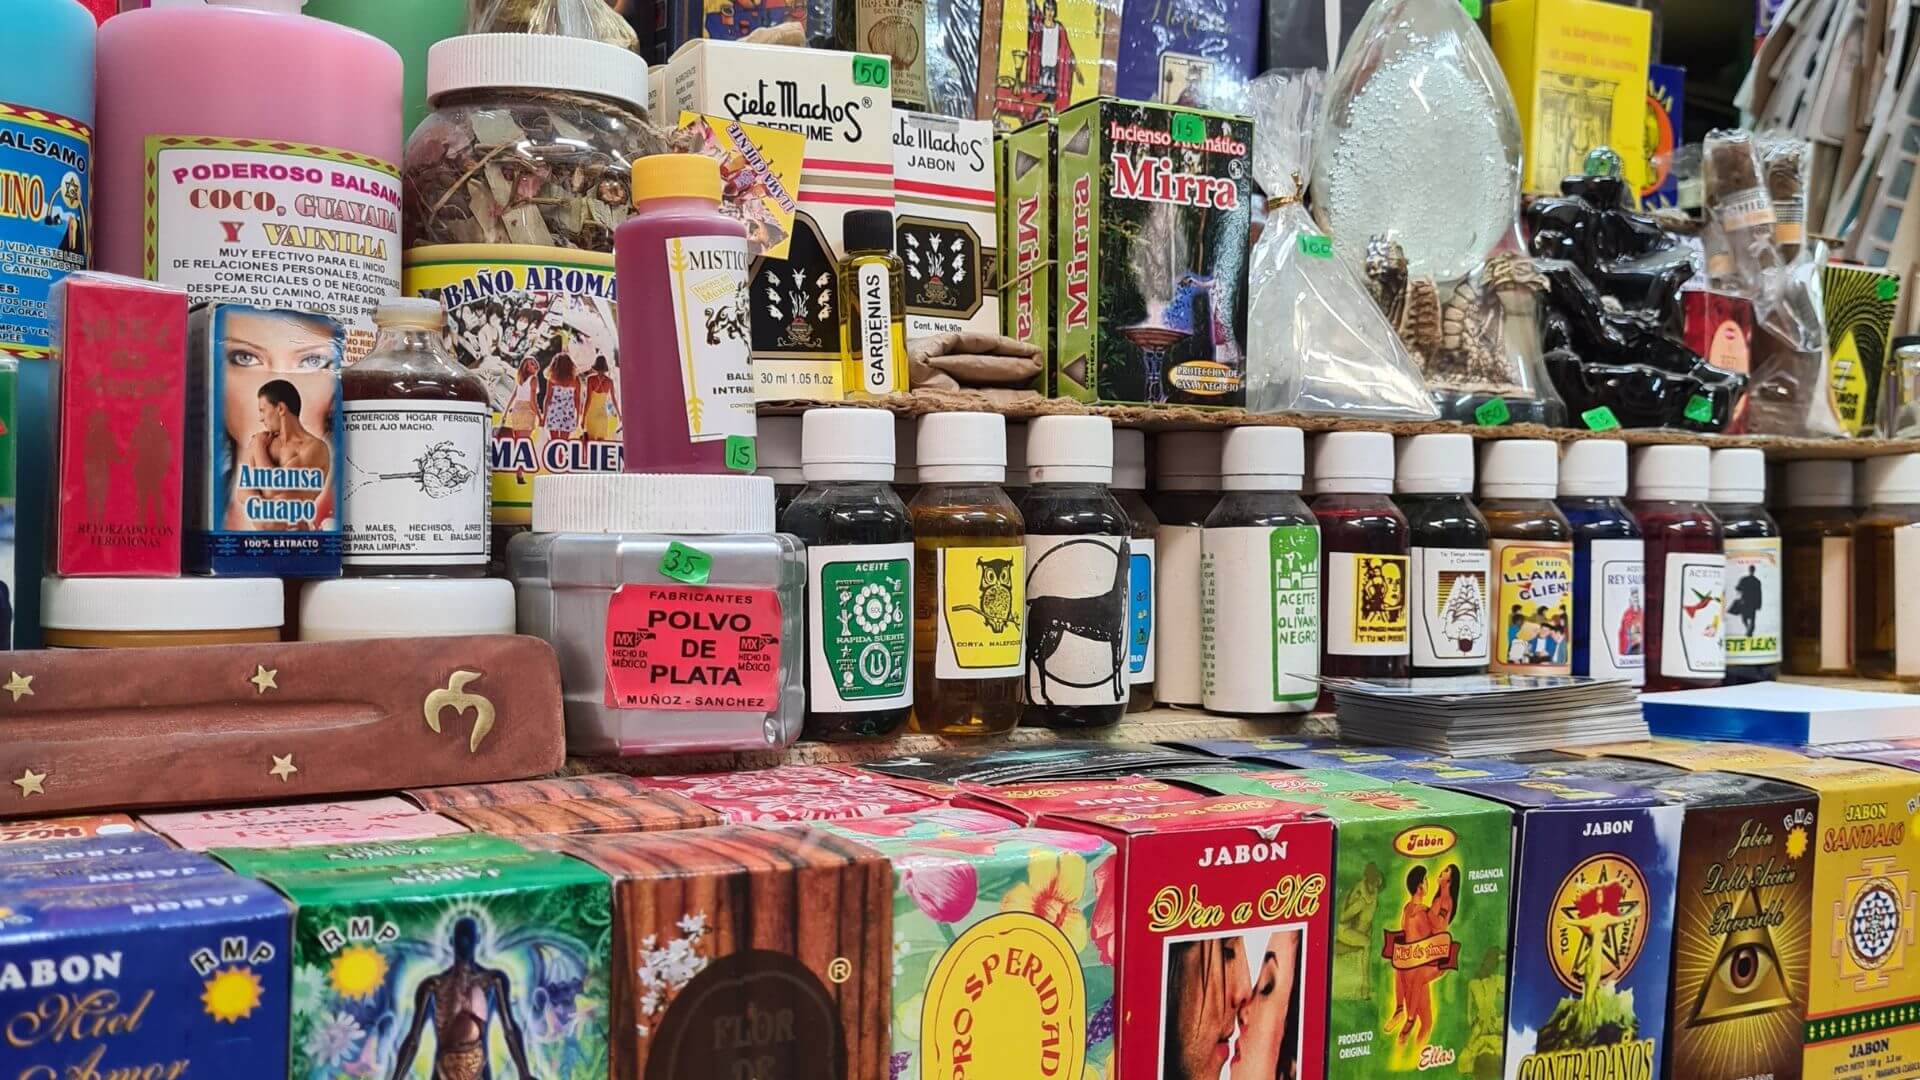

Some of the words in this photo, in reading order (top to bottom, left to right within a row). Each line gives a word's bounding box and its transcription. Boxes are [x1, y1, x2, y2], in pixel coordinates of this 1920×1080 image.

[1110, 120, 1172, 145] Incienso
[1174, 138, 1246, 156] mático
[1176, 122, 1193, 137] 15
[0, 130, 86, 173] ALSAMO
[907, 155, 956, 172] JABON
[172, 163, 324, 184] PODEROSO
[1111, 152, 1239, 210] Mirra
[0, 171, 44, 220] INO
[764, 172, 797, 214] LLAMA
[189, 187, 287, 217] COCO,
[294, 193, 398, 234] GUAYABA
[8, 241, 37, 254] VIDA
[218, 220, 246, 244] Y
[262, 222, 388, 261] VAINILLA
[219, 247, 249, 259] MUY
[251, 249, 315, 264] EFECTIVO
[317, 255, 347, 268] PARA
[349, 258, 361, 270] EL
[362, 262, 387, 274] INICIO
[1066, 175, 1091, 332] Mirra
[173, 259, 190, 269] DE
[193, 259, 279, 274] RELACIONES
[282, 263, 361, 281] PERSONALES,
[1017, 193, 1040, 343] Mirra
[0, 283, 19, 294] ES:
[214, 272, 309, 287] COMERCIALES
[311, 278, 321, 288] O
[324, 279, 340, 290] DE
[443, 267, 515, 310] BAÑO
[525, 265, 617, 304] AROMÁ
[186, 283, 247, 295] DESPEJA
[250, 285, 269, 296] SU
[272, 287, 325, 301] CAMINO,
[327, 291, 361, 303] ATRAE
[274, 298, 293, 310] EN
[295, 300, 337, 313] TODOS
[338, 305, 360, 317] SUS
[0, 324, 28, 334] MPIAS
[866, 274, 886, 386] GARDENIAS
[913, 320, 933, 331] Cont.
[760, 372, 773, 385] 30
[776, 372, 788, 385] ml
[790, 372, 811, 386] 1.05
[379, 423, 398, 431] AJO
[399, 423, 434, 431] MACHO.
[546, 440, 624, 473] CLIEN
[731, 442, 750, 466] 15
[238, 462, 323, 490] Amansa
[245, 497, 316, 523] Guapo
[365, 524, 397, 532] MALES,
[409, 524, 455, 532] HECHISOS,
[433, 533, 443, 541] EL
[243, 538, 271, 549] 100%
[273, 538, 319, 549] EXTRACTO
[353, 543, 375, 551] PARA
[662, 548, 702, 574] 35
[855, 562, 890, 573] ACEITE
[1503, 571, 1567, 583] LLAMA
[1607, 574, 1624, 585] REY
[650, 591, 753, 604] FABRICANTES
[1279, 592, 1316, 606] ACEITE
[1518, 582, 1571, 600] CLIENT
[648, 610, 752, 632] POLVO
[1295, 607, 1306, 616] DE
[612, 650, 637, 658] HECHO
[681, 639, 717, 658] DE
[956, 641, 984, 649] CORTA
[611, 658, 647, 669] MÉXICO
[737, 662, 771, 673] MÉXICO
[738, 654, 761, 662] HECHO
[650, 665, 743, 686] PLATA
[626, 694, 682, 705] MUÑOZ
[694, 697, 766, 707] SANCHEZ
[1845, 802, 1889, 822] JABON
[1582, 820, 1635, 837] JABON
[1822, 820, 1906, 853] SANDALO
[43, 846, 145, 861] JABON
[1198, 840, 1289, 867] JABON
[88, 866, 197, 884] JABON
[1468, 868, 1505, 881] FRAGANCIA
[1473, 883, 1499, 894] CLASICA
[130, 894, 249, 915] JABON
[1148, 884, 1225, 933] Ven
[1232, 903, 1255, 922] a
[1256, 872, 1328, 921] Mi
[319, 915, 401, 953] RMP
[190, 935, 276, 978] RMP
[0, 951, 124, 991] ABON
[6, 988, 156, 1046] Miel
[712, 1006, 797, 1050] FLOR
[1337, 1030, 1374, 1046] PRODUCTO
[1339, 1045, 1372, 1060] ORIGINAL
[1418, 1044, 1456, 1071] Ellas
[1849, 1037, 1890, 1059] JABON
